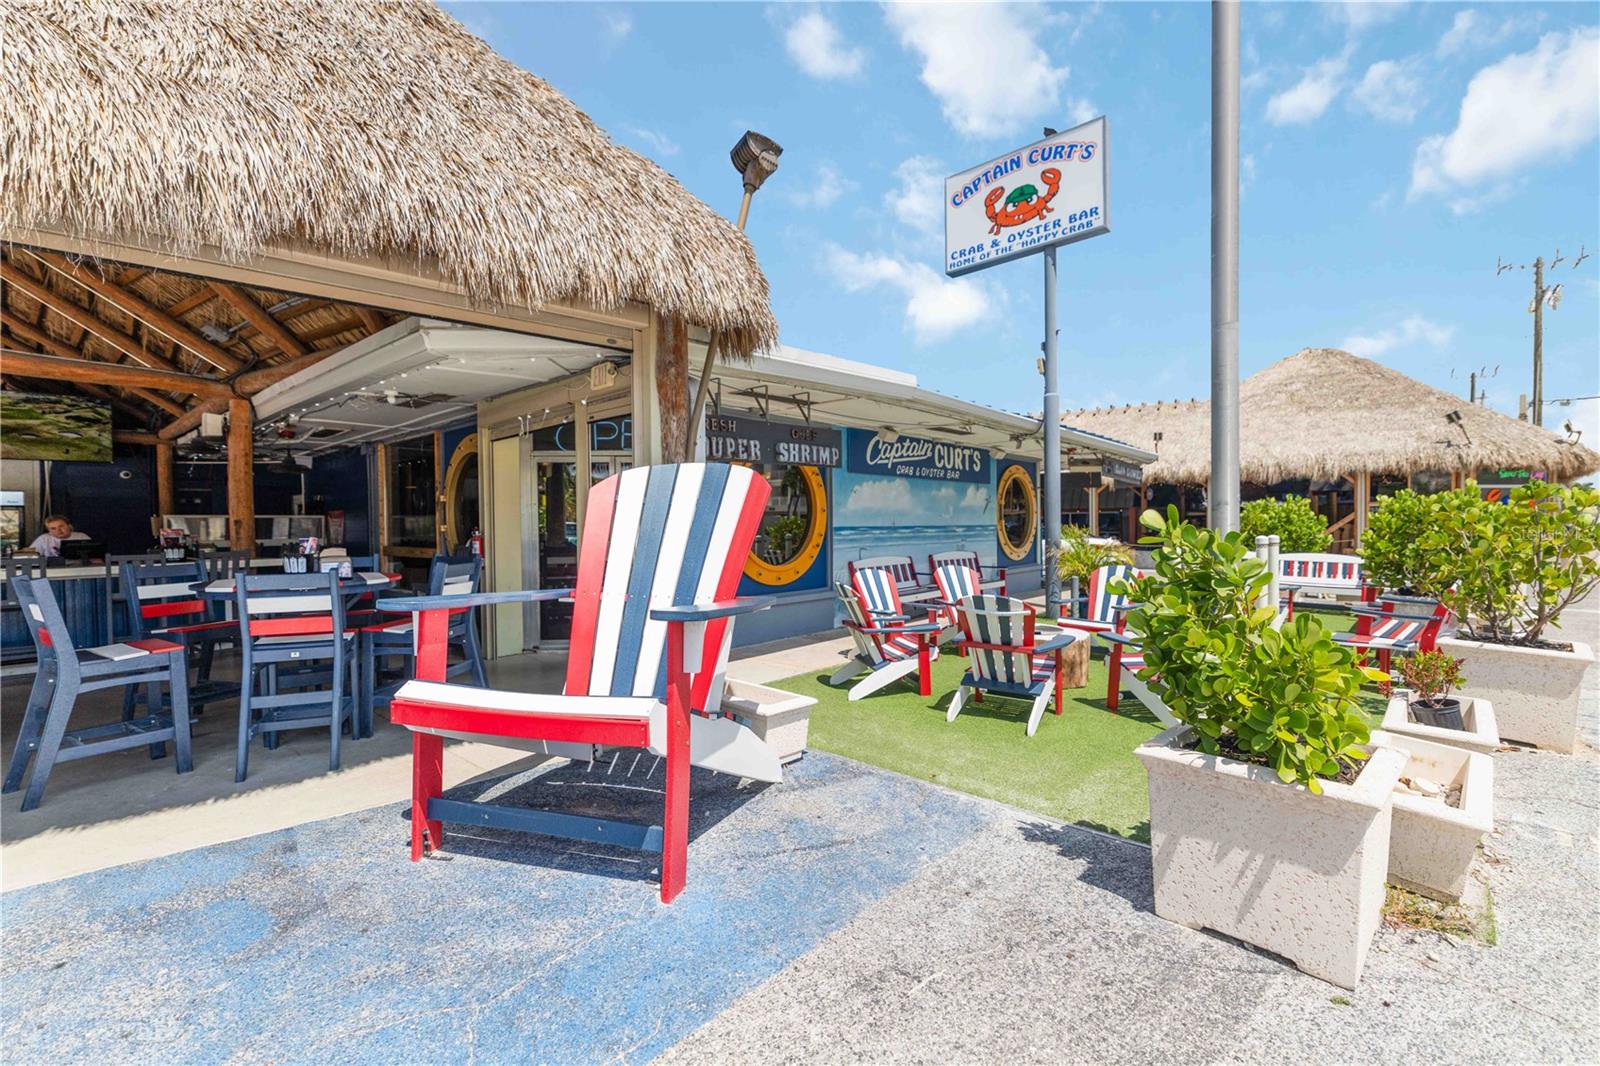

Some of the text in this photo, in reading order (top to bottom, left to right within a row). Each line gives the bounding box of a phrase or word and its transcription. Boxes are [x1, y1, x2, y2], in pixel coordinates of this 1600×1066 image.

[951, 142, 1096, 207] CAPTAIN CURT'S
[951, 206, 1099, 260] CRAB & OYSTER BAR
[949, 256, 976, 269] HOME
[979, 251, 991, 262] OF
[995, 245, 1013, 257] THE
[777, 442, 840, 466] SHRIMP
[866, 436, 981, 472] Captain CURT'S
[896, 465, 960, 479] CRAB & OYSTER BAR
